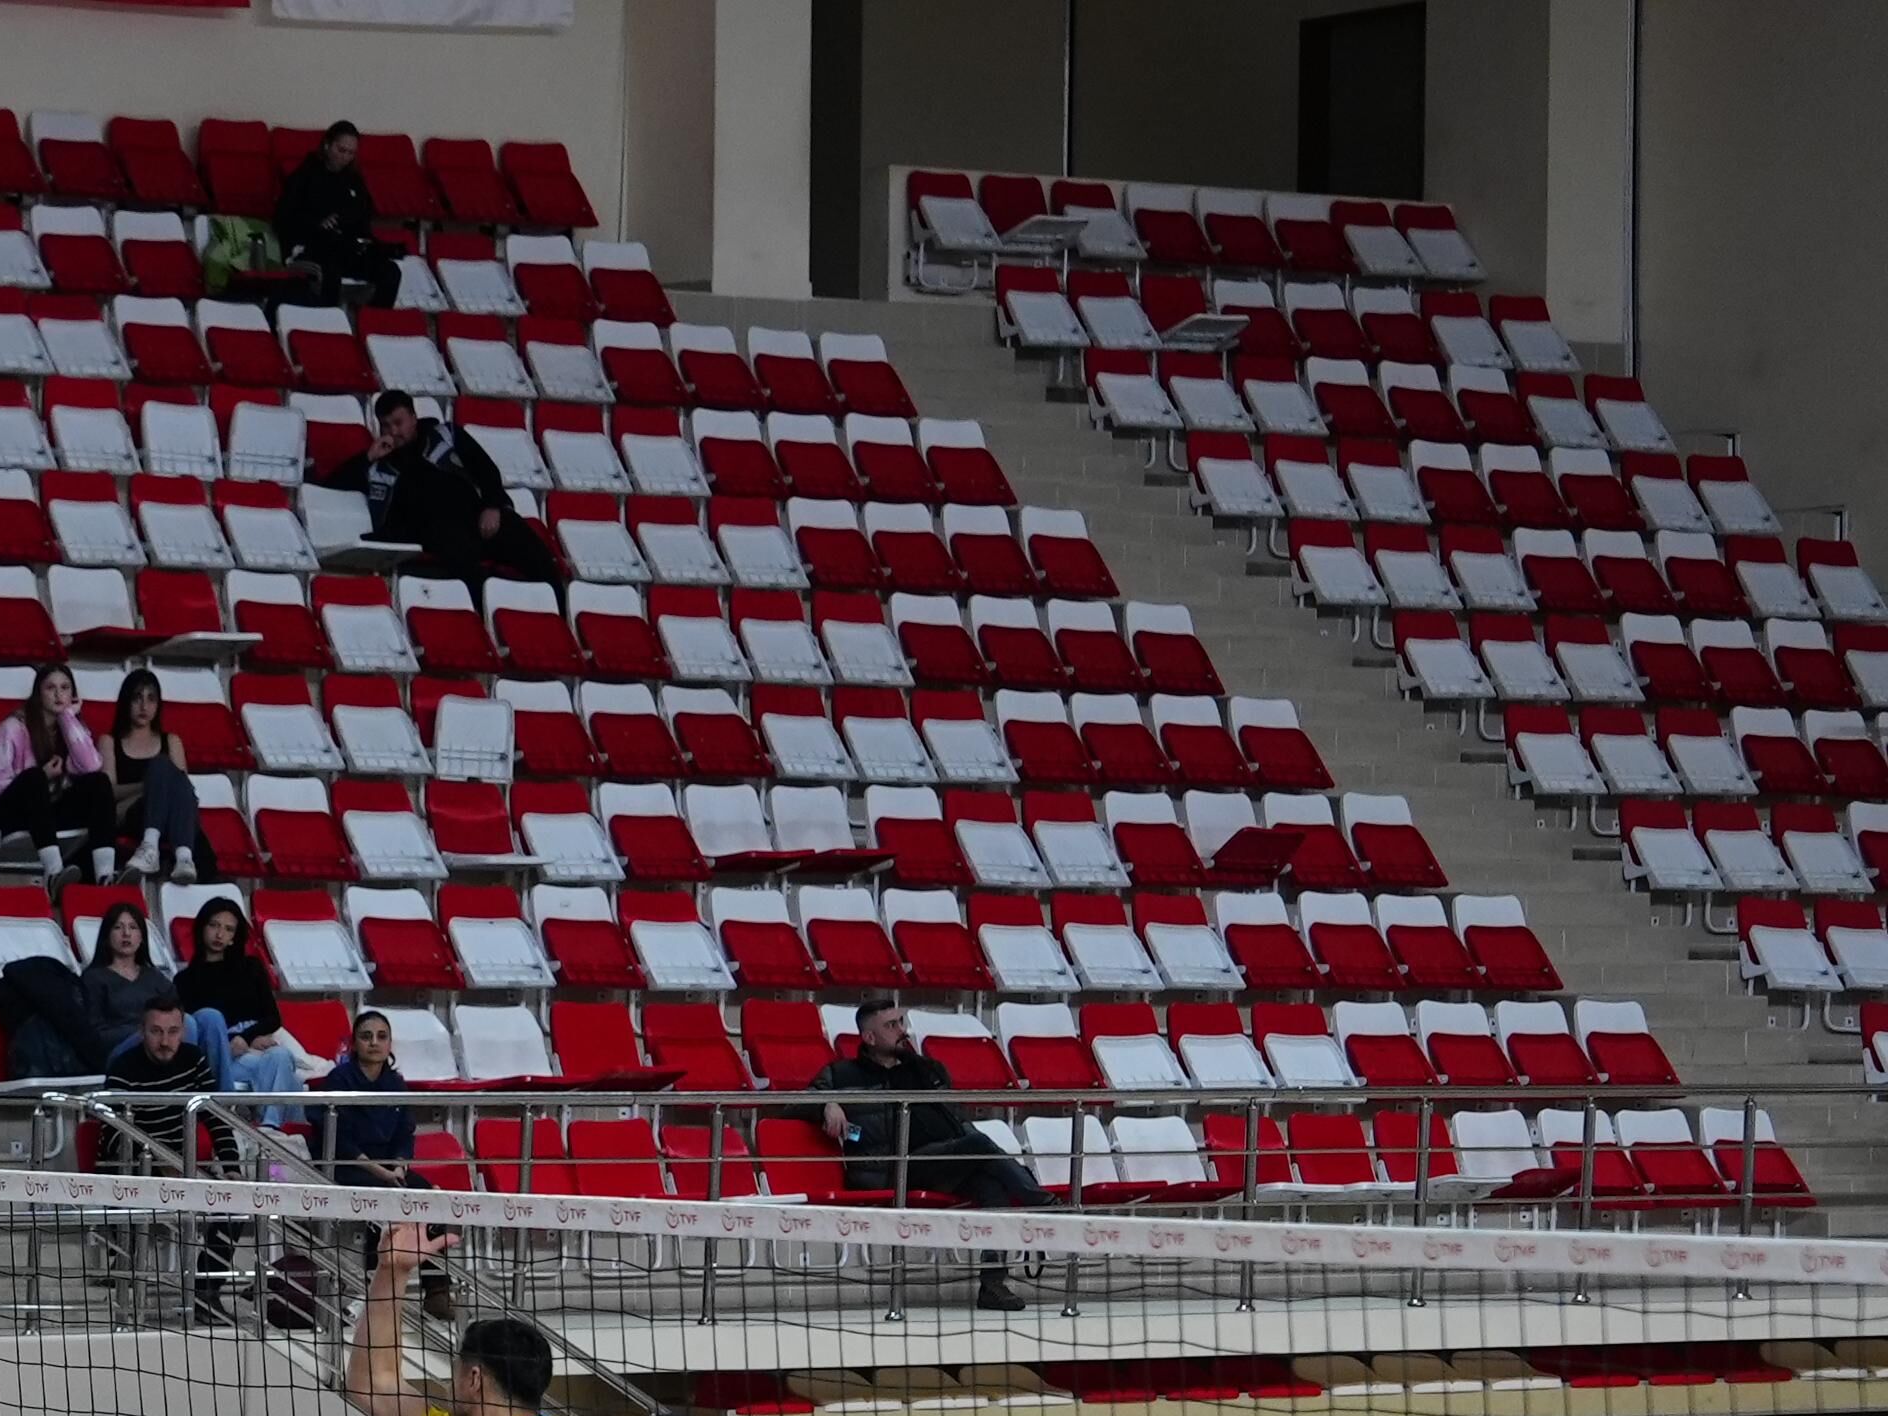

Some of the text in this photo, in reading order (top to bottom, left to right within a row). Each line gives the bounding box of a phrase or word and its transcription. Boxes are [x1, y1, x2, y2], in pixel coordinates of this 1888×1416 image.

[35, 1182, 49, 1193] TVF
[79, 1185, 94, 1195] TVF
[124, 1187, 139, 1197] TVF
[170, 1190, 185, 1200] TVF
[216, 1192, 232, 1201] TVF
[264, 1194, 280, 1204] TVF
[313, 1197, 329, 1207] TVF
[362, 1199, 378, 1209] TVF
[413, 1201, 429, 1211] TVF
[465, 1203, 481, 1214] TVF
[517, 1206, 533, 1216] TVF
[569, 1208, 587, 1218] TVF
[624, 1210, 641, 1221] TVF
[680, 1213, 697, 1224] TVF
[736, 1216, 754, 1228] TVF
[793, 1219, 811, 1229] TVF
[853, 1221, 871, 1231] TVF
[912, 1223, 931, 1234] TVF
[974, 1226, 992, 1236] TVF
[1035, 1228, 1055, 1238] TVF
[1098, 1230, 1120, 1241] TVF
[1164, 1232, 1185, 1244] TVF
[1231, 1235, 1253, 1246] TVF
